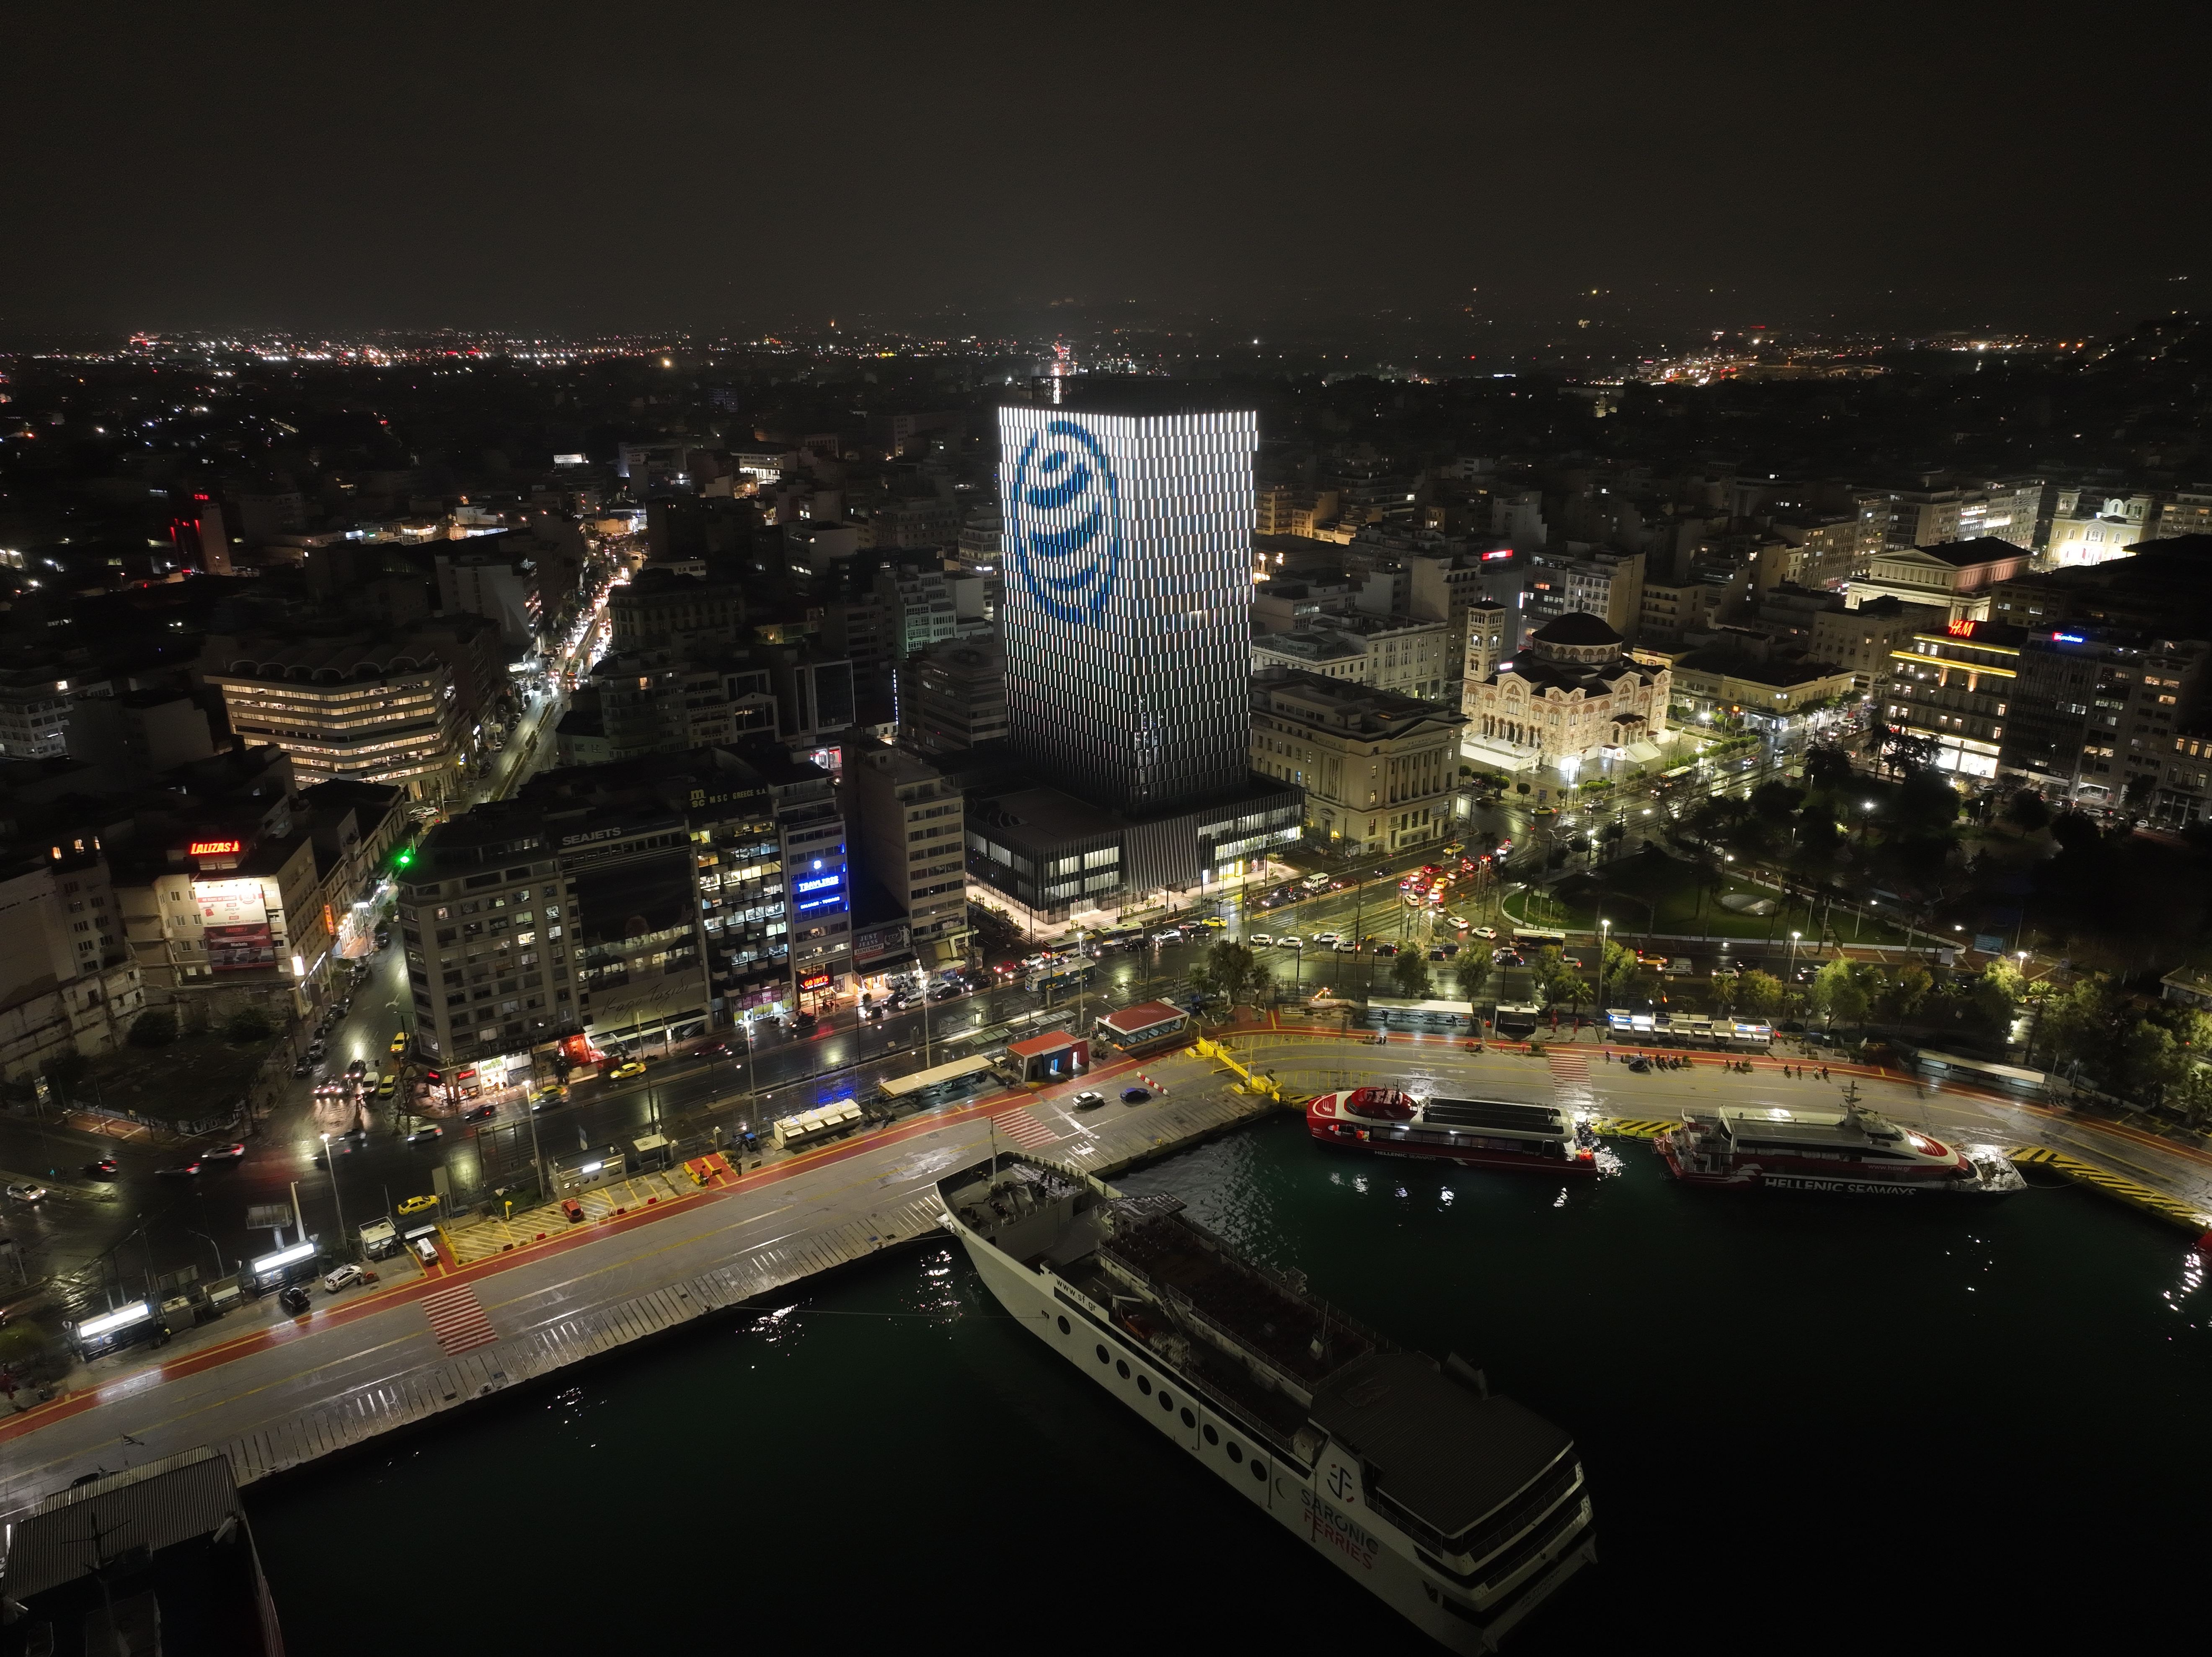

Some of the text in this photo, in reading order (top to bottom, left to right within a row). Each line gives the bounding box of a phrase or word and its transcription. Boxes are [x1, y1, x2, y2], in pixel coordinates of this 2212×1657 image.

[1949, 620, 1974, 637] H&M
[733, 789, 754, 800] GREECE
[562, 827, 622, 846] SEAJETS
[191, 843, 231, 854] LALIZAS
[858, 939, 878, 948] JEANS
[860, 933, 878, 942] JUST
[1868, 1164, 1911, 1173] www.hsw.gr
[1764, 1177, 1917, 1196] HELLENIC SEAWAYS
[1056, 1278, 1097, 1311] www.sf.gr
[1301, 1488, 1379, 1555] SARONIC
[1304, 1507, 1372, 1570] FERRIES
